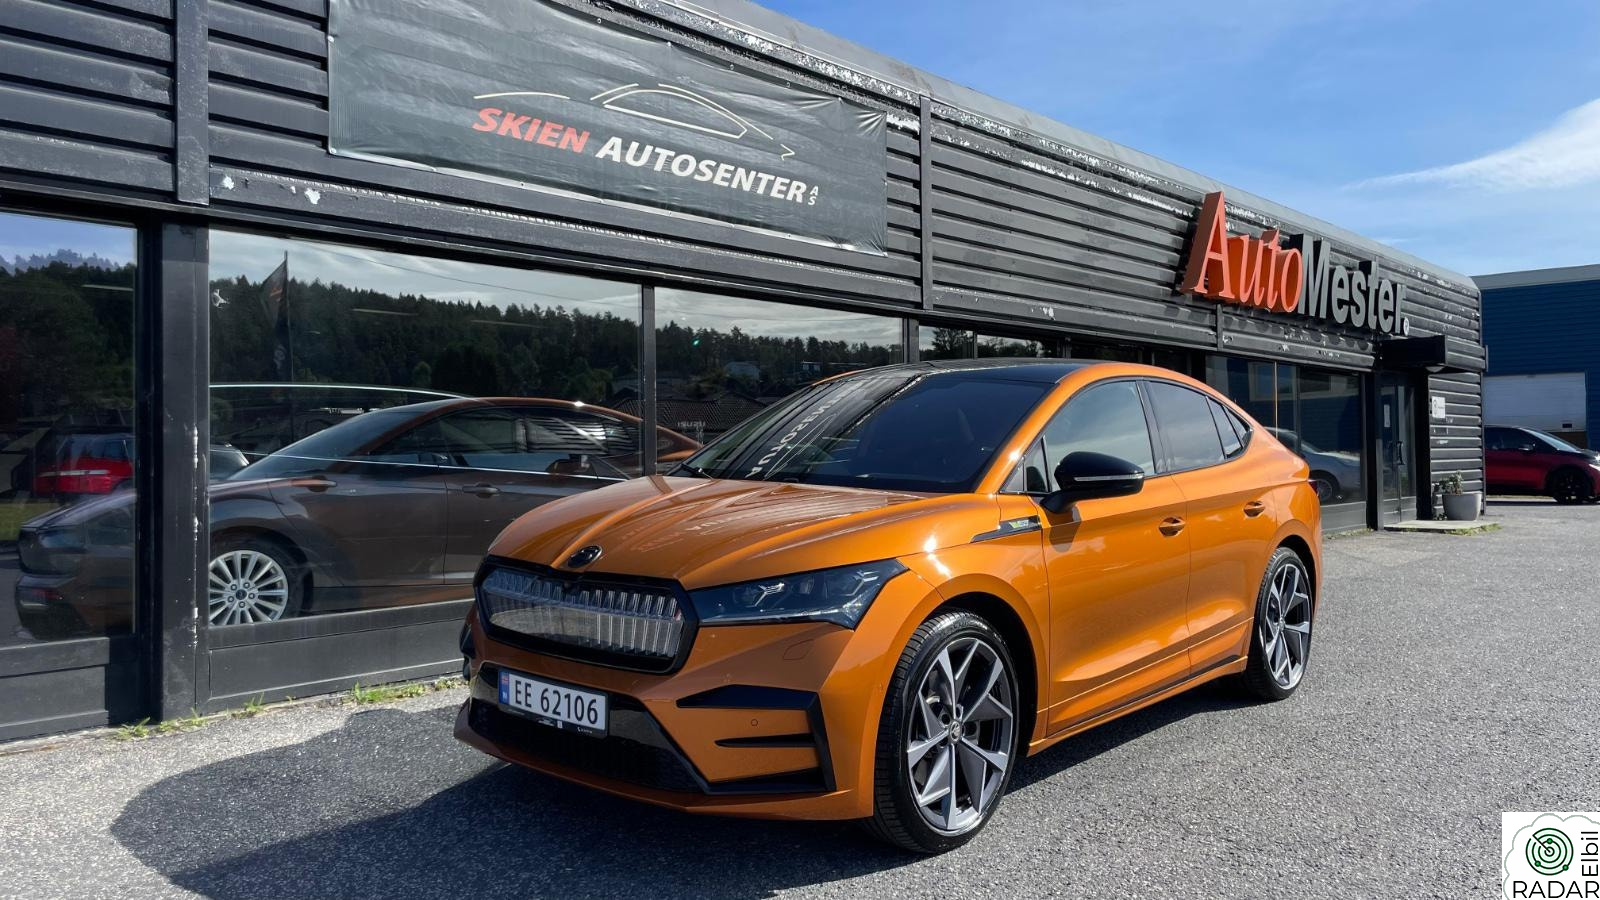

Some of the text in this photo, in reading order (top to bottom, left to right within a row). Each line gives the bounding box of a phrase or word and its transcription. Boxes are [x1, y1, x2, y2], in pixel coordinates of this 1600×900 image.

[472, 107, 590, 154] SKIEN
[596, 136, 807, 203] AUTOSENTER
[515, 680, 598, 725] EE 62106
